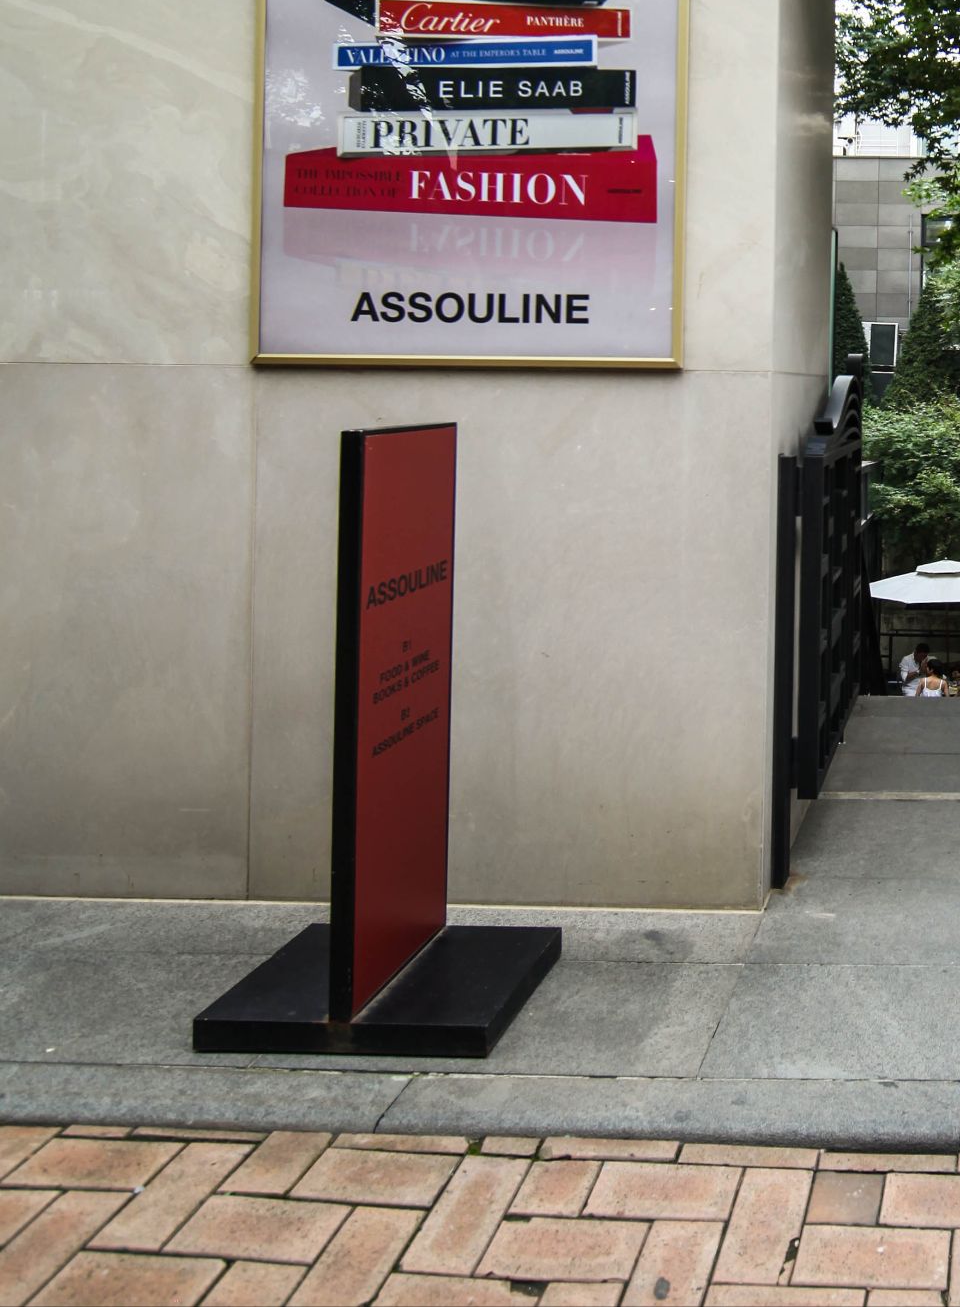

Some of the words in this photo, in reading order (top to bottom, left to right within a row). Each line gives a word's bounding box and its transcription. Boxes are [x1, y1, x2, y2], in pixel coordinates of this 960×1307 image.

[400, 2, 500, 34] Cartier
[526, 15, 584, 28] PANTHÈRE
[463, 50, 476, 58] THE
[522, 48, 547, 57] TABLE
[439, 80, 504, 98] ELIE
[518, 80, 583, 98] SAAB
[369, 118, 530, 149] PRIVATE
[409, 169, 589, 207] FASHION
[351, 291, 590, 324] ASSOULINE
[366, 560, 447, 610] ASSOULINE
[372, 679, 402, 705] BOOKS
[411, 660, 440, 685] COFFEE
[379, 664, 403, 684] FOOD
[372, 723, 415, 758] ASSOULINE
[416, 707, 440, 731] SPACE
